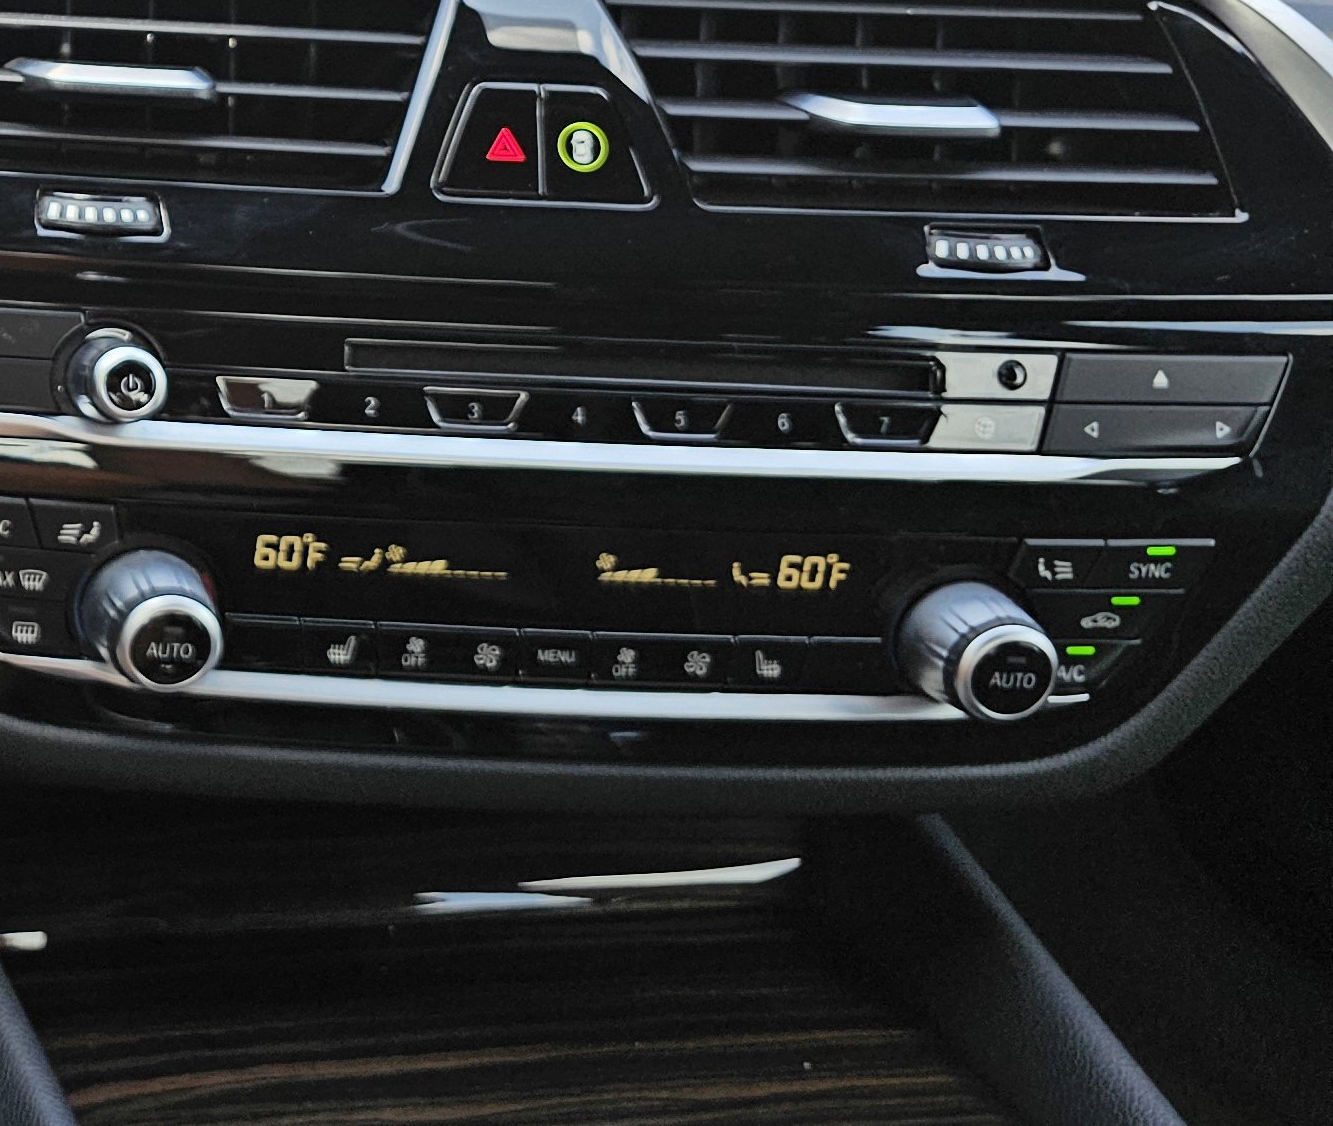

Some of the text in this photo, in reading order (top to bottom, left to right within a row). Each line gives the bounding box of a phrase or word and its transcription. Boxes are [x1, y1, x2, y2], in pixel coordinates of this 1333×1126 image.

[364, 396, 381, 418] 2
[467, 402, 483, 422] 3
[571, 406, 587, 426] 4
[673, 410, 690, 430] 5
[777, 413, 793, 433] 6
[879, 416, 891, 434] 7
[253, 532, 331, 571] 60°F
[776, 553, 852, 591] 60°F
[1128, 561, 1173, 580] SYNC
[146, 642, 194, 661] AUTO
[401, 653, 427, 667] OFF
[537, 648, 576, 663] MENU
[611, 664, 637, 678] OFF
[988, 670, 1037, 689] AUTO
